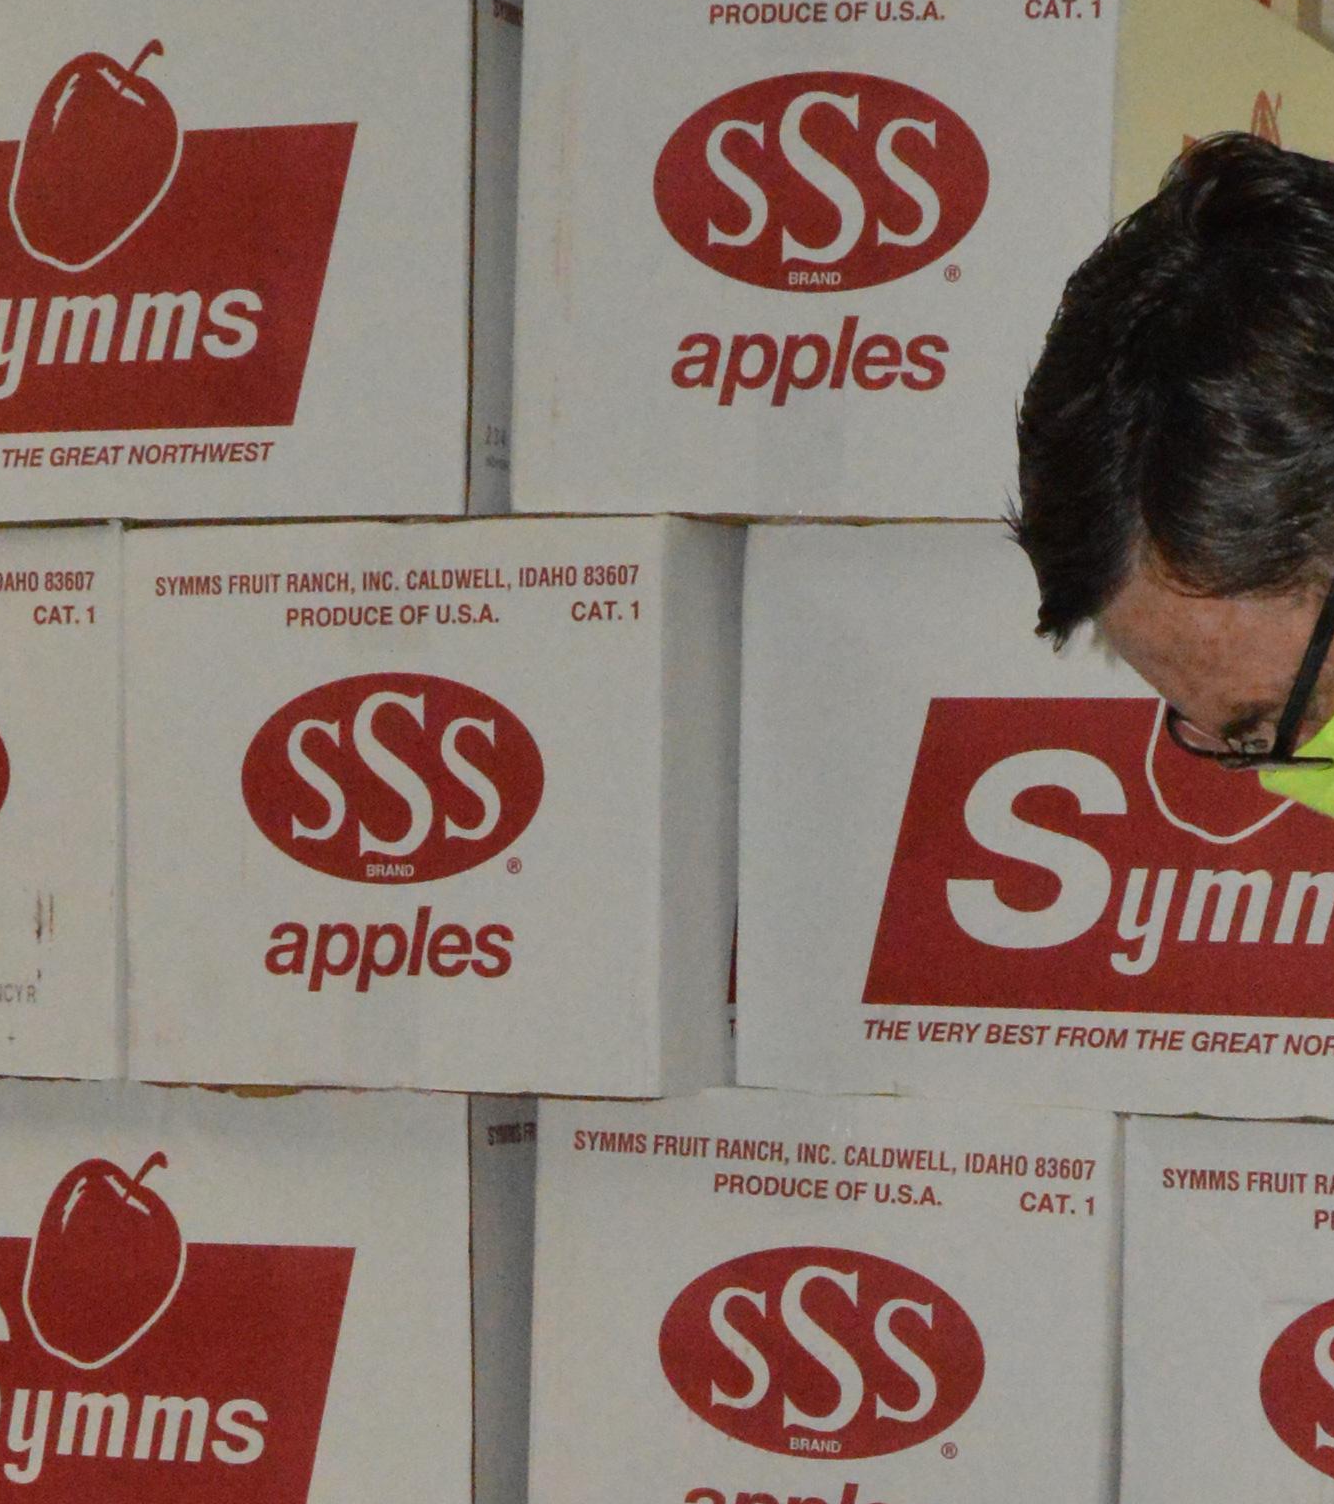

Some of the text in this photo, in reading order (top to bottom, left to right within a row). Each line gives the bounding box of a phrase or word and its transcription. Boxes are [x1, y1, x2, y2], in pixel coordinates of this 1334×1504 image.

[708, 0, 945, 25] PRODUCE OF U.S.A.
[705, 90, 941, 264] SSS
[787, 271, 842, 286] BRAND
[670, 316, 949, 406] apples
[2, 447, 44, 468] THE
[49, 444, 125, 468] GREAT
[127, 440, 275, 465] NORTHWEST
[287, 691, 501, 857] SSS
[366, 863, 415, 878] BRAND
[264, 906, 514, 993] apples
[864, 1018, 912, 1042] THE
[917, 1020, 982, 1044] VERY
[984, 1022, 1051, 1046] BEST
[1054, 1025, 1129, 1049] FROM
[1136, 1028, 1186, 1051] THE
[1190, 1030, 1279, 1054] GREAT
[713, 1172, 942, 1206] PRODUCE OF U.S.A.
[1019, 1190, 1095, 1215] CAT. 1
[708, 1264, 937, 1433] SSS
[789, 1437, 842, 1455] BRAND
